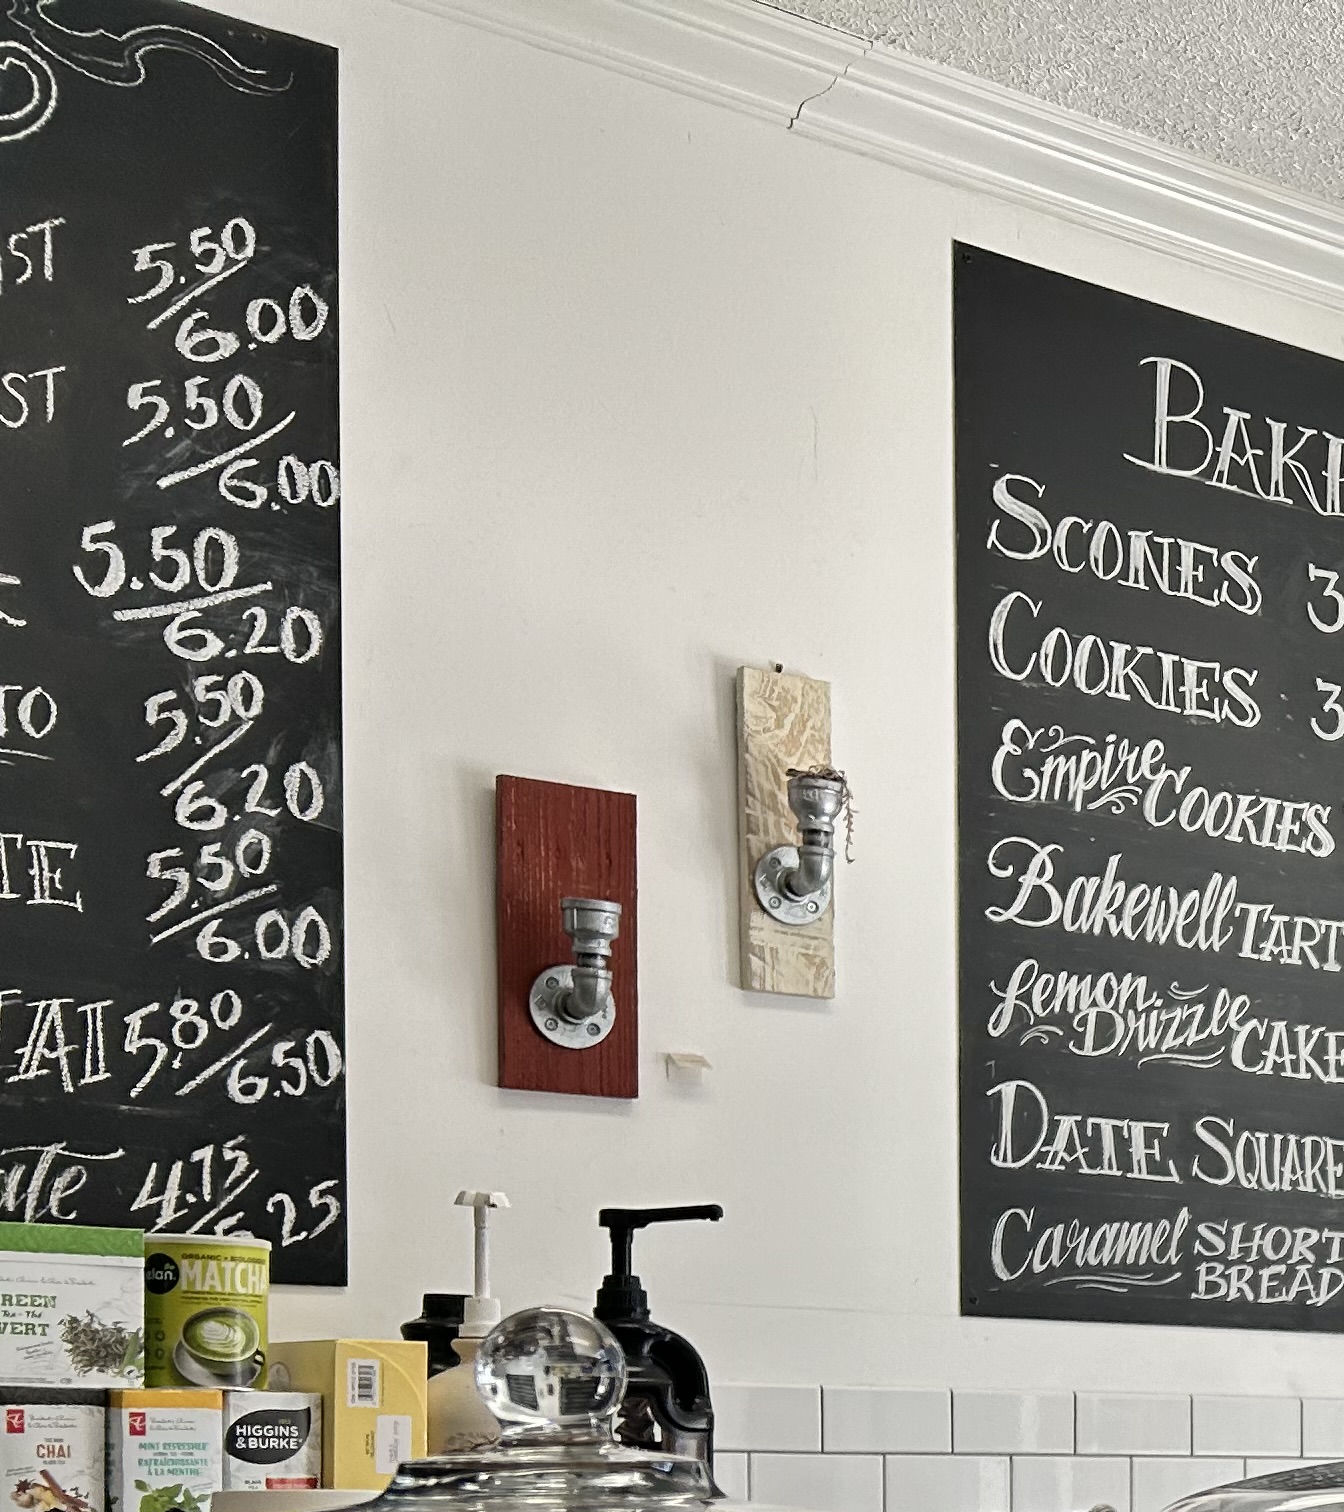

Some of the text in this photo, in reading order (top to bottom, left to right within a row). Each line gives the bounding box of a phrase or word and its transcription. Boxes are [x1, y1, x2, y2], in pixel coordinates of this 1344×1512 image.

[987, 473, 1263, 615] SCONES
[988, 591, 1262, 728] COOKIES
[991, 718, 1168, 814] Empire
[1142, 766, 1336, 858] COOKIES
[985, 836, 1239, 954] Bakewell
[987, 958, 1162, 1037] Lemon
[1068, 988, 1252, 1057] Drizzle
[986, 1079, 1182, 1184] DATE
[181, 1260, 267, 1294] MATCHA
[990, 1206, 1192, 1284] Caramel
[36, 1444, 72, 1458] CHAI
[235, 1424, 299, 1437] HIGGINS
